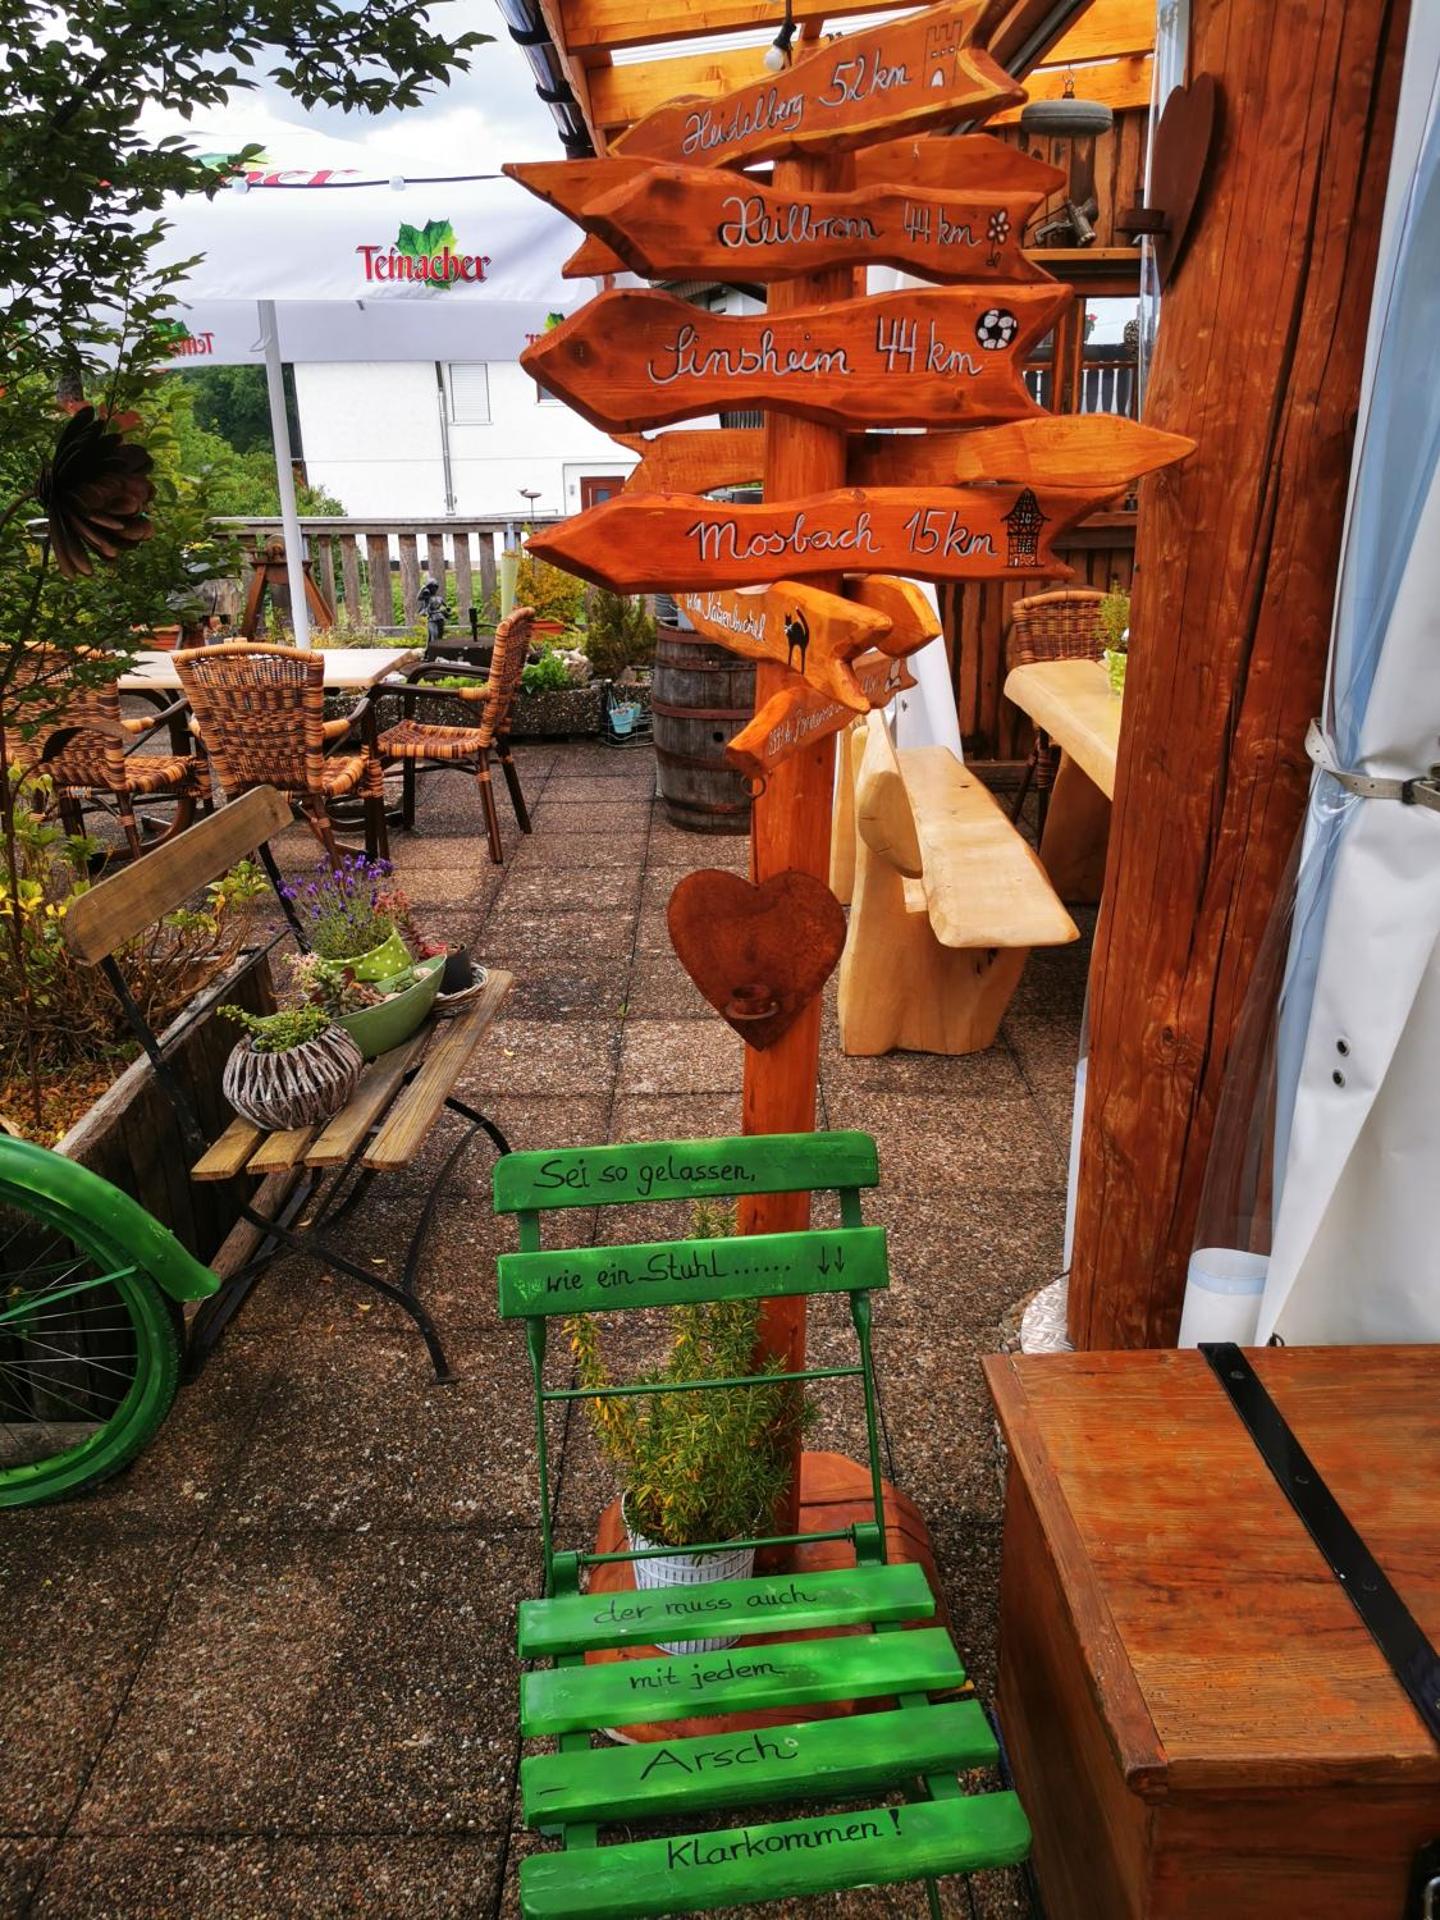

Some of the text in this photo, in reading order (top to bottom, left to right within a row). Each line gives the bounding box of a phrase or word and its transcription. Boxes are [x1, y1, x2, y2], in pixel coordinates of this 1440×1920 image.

[681, 87, 806, 154] Heidelberg
[717, 195, 885, 248] Heilbronn
[936, 206, 982, 247] km
[355, 245, 492, 283] Teinacher
[648, 315, 984, 384] Sinsheim 44 km
[686, 512, 884, 561] Mosbach
[533, 1155, 757, 1196] Sei so gelassen,
[546, 1268, 584, 1293] wie
[597, 1262, 635, 1288] ein
[593, 1583, 819, 1625] der muss auch
[629, 1658, 785, 1691] mit jedem
[640, 1733, 799, 1781] Arsch
